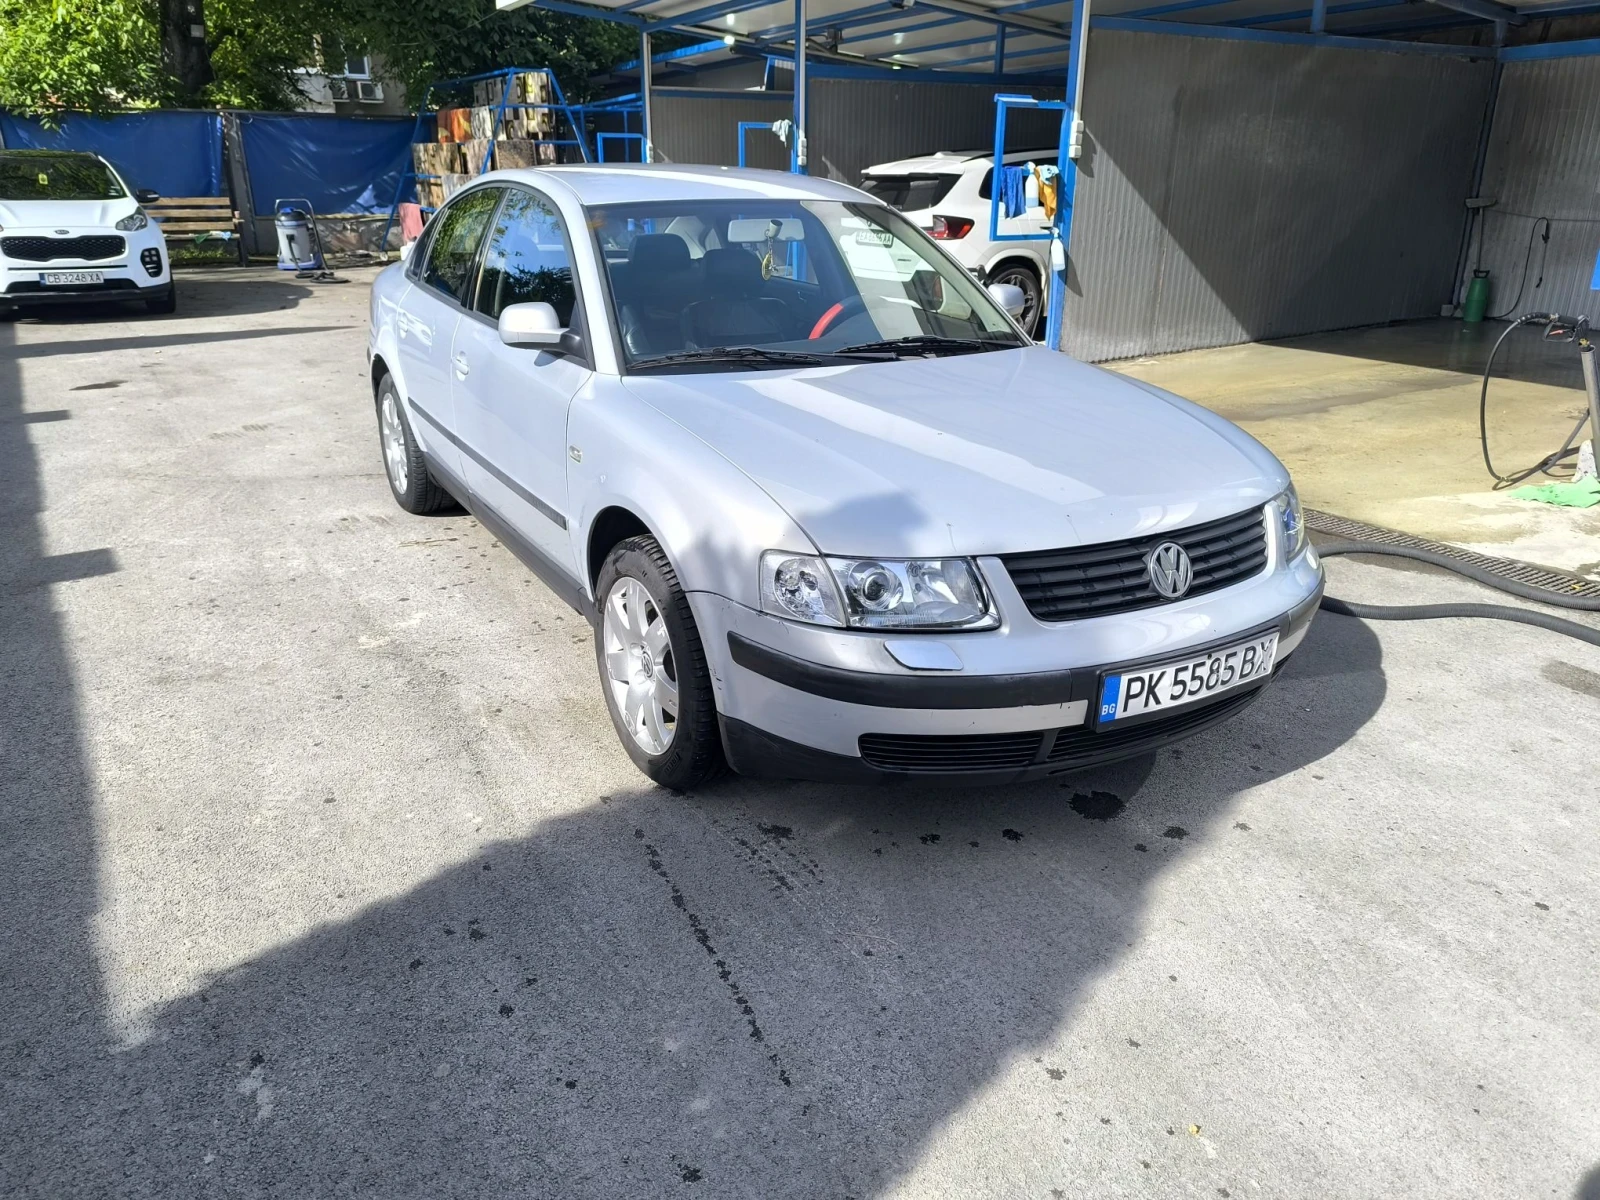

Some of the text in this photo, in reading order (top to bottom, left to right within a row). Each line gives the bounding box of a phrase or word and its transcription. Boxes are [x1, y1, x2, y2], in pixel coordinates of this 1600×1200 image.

[47, 273, 61, 284] CB
[62, 273, 87, 283] 3248
[88, 273, 101, 282] XA
[1102, 638, 1274, 716] BG PK 5585 BX
